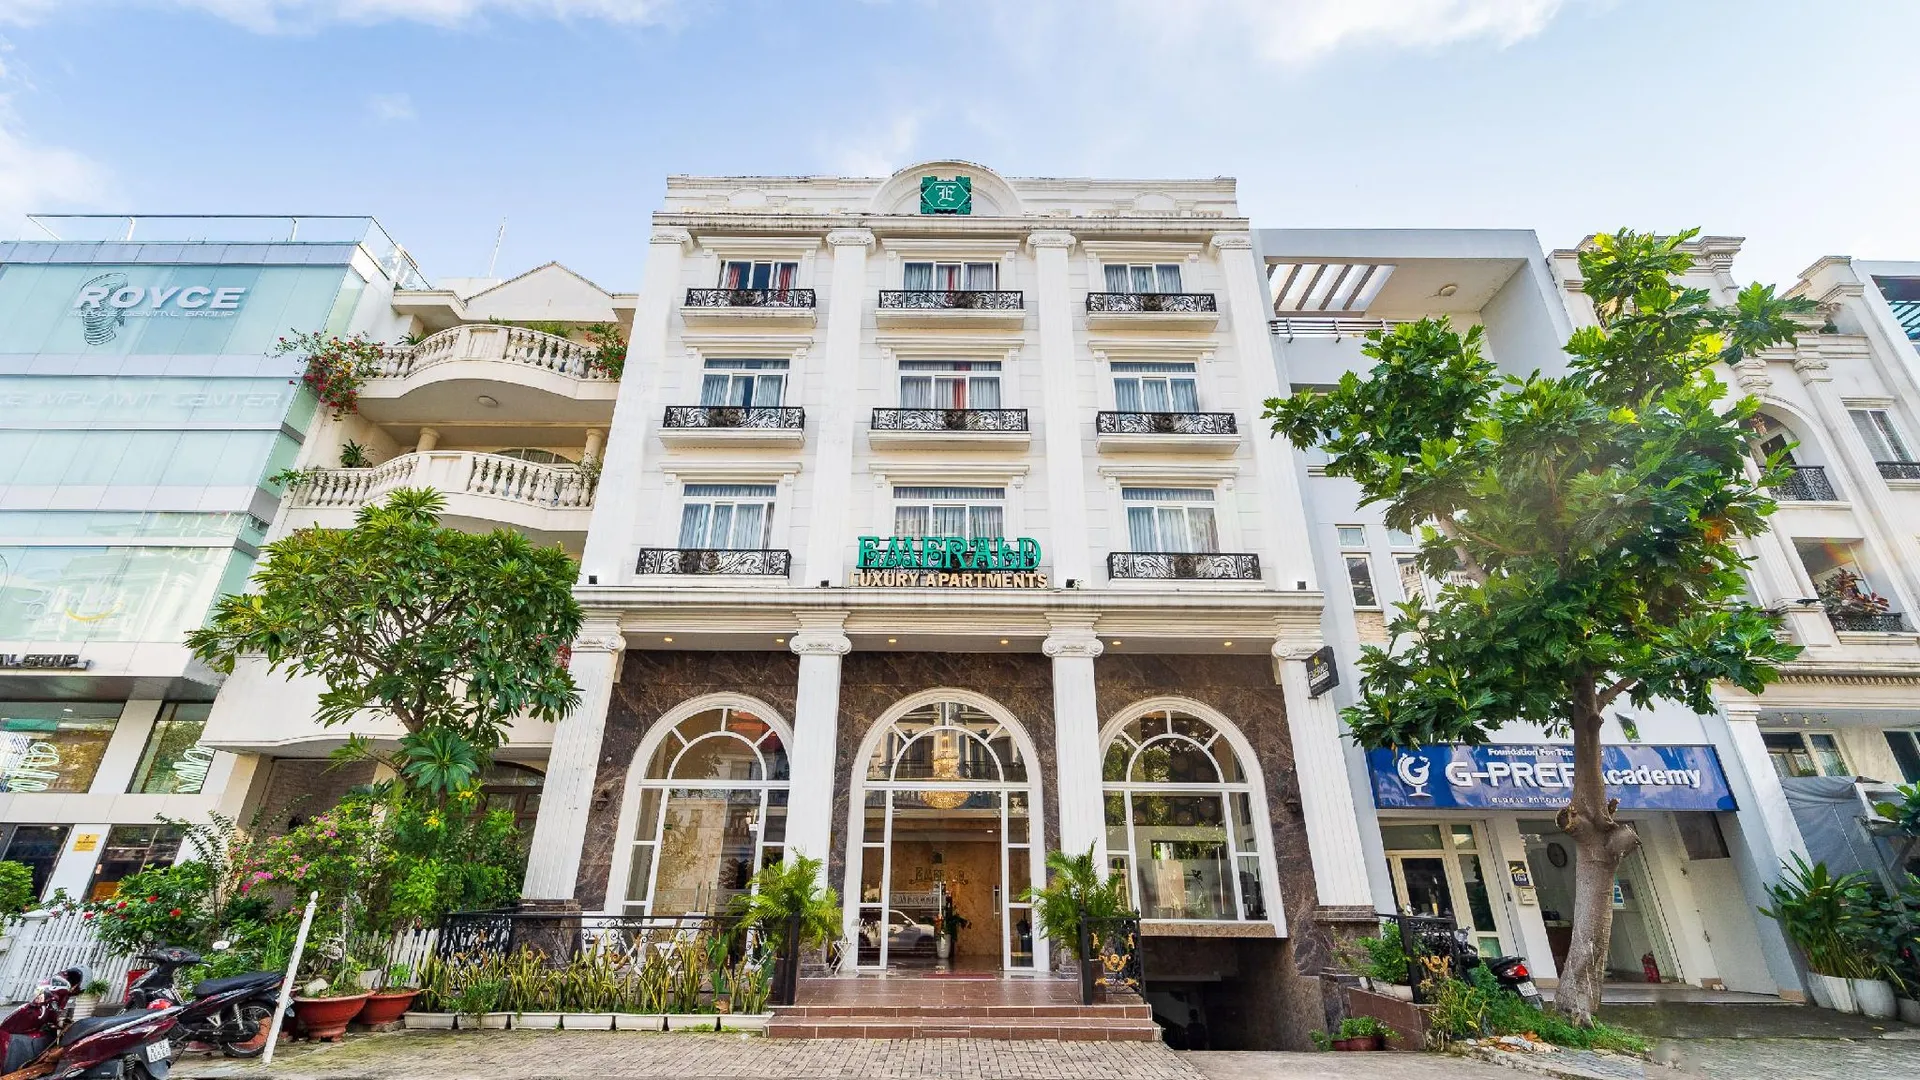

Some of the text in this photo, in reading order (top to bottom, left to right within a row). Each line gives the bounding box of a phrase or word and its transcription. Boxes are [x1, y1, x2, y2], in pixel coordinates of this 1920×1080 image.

[72, 285, 247, 309] ROYCE
[184, 310, 235, 318] GROUP
[856, 536, 1042, 570] EMERALD
[850, 572, 1048, 588] LUXURY APARTMENTS
[1488, 748, 1538, 756] Foundation
[1539, 748, 1555, 756] For
